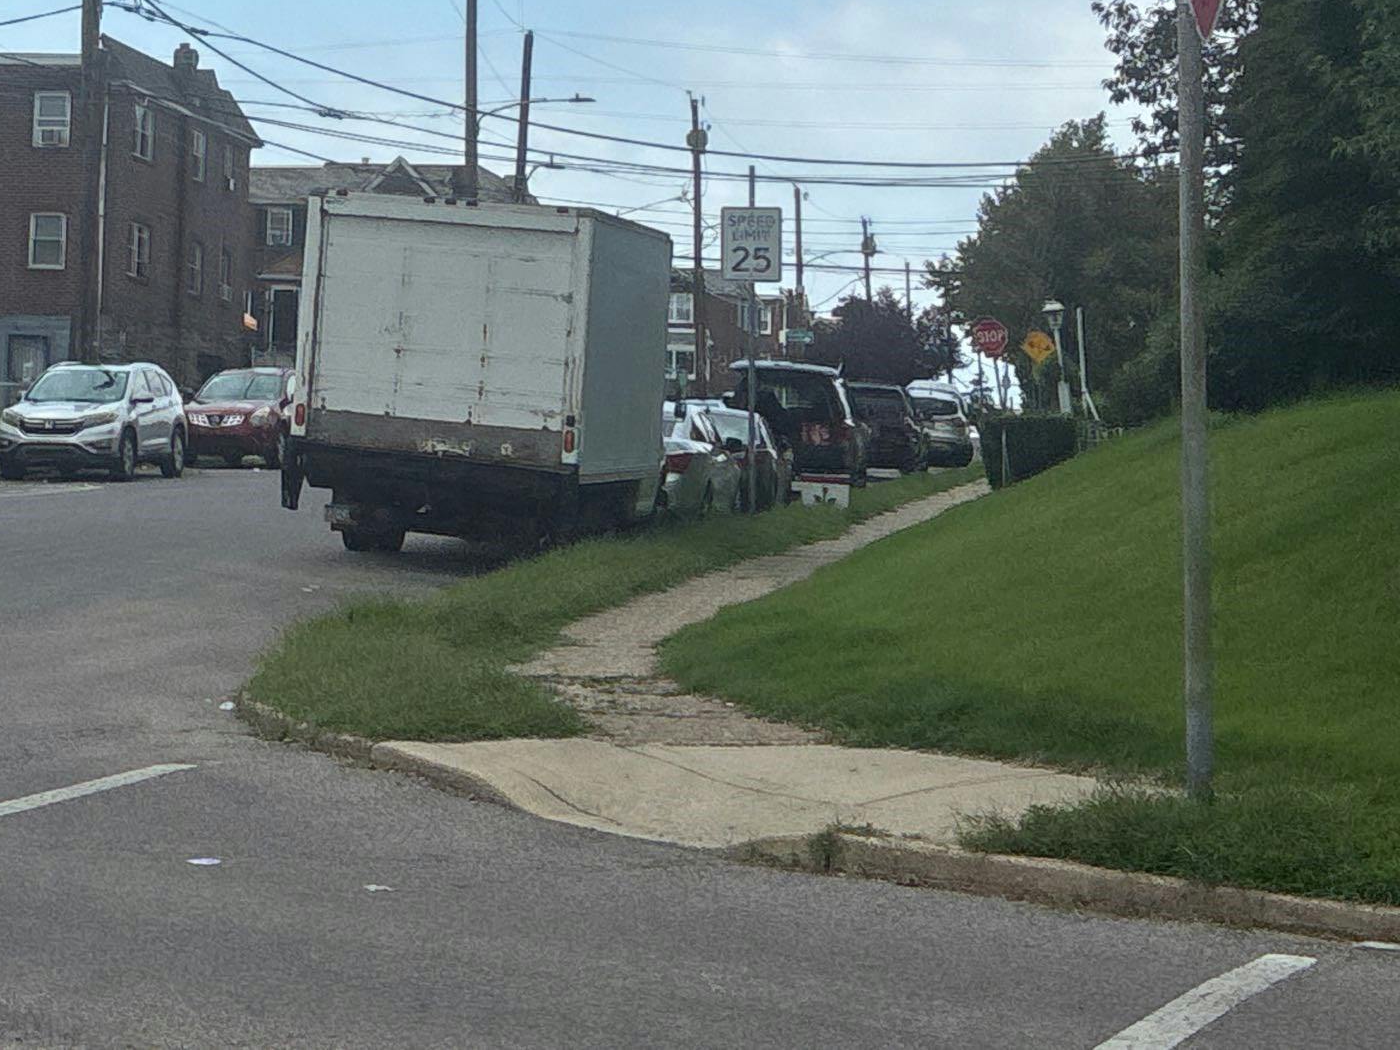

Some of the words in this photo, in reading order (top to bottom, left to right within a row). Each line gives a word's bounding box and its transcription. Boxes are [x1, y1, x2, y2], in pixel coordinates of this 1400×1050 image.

[728, 214, 776, 229] SPEED
[731, 230, 770, 242] LIMIT
[731, 246, 772, 273] 25
[976, 330, 1004, 344] STOP
